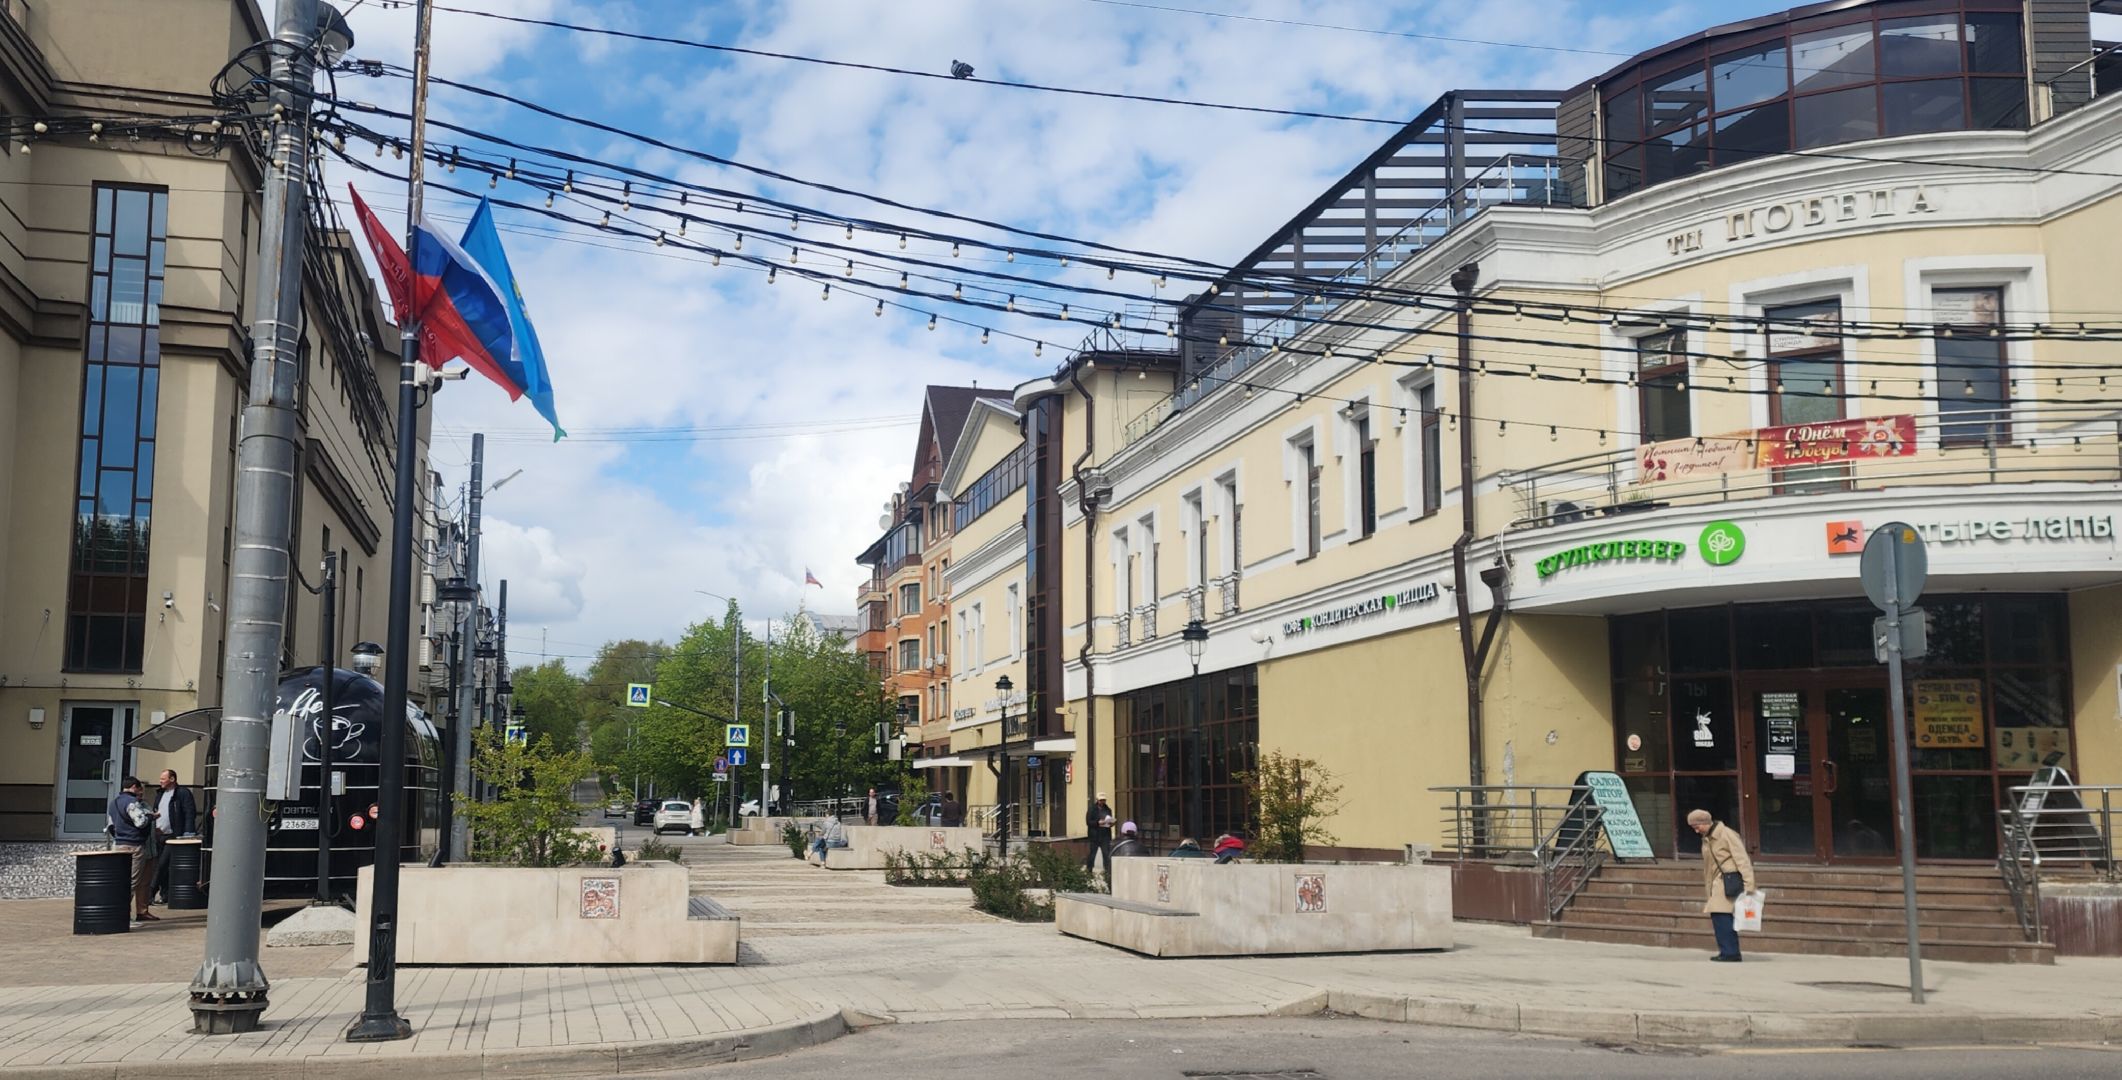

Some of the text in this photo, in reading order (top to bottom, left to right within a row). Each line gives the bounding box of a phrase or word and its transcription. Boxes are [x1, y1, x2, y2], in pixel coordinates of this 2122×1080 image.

[1667, 184, 1938, 256] ТЦ ПОБЕДА
[1785, 425, 1846, 443] С Днём
[1918, 514, 2114, 542] тыре лапы
[1534, 540, 1687, 579] КУУЛКЛЕВЕР
[1282, 583, 1438, 635] КОФЕ КОНДИТЕРСКАЯ ПИЦЦА
[1928, 724, 1970, 735] ОДЕЖДА
[1589, 777, 1621, 787] САЛОН
[1597, 788, 1623, 798] ШТОР
